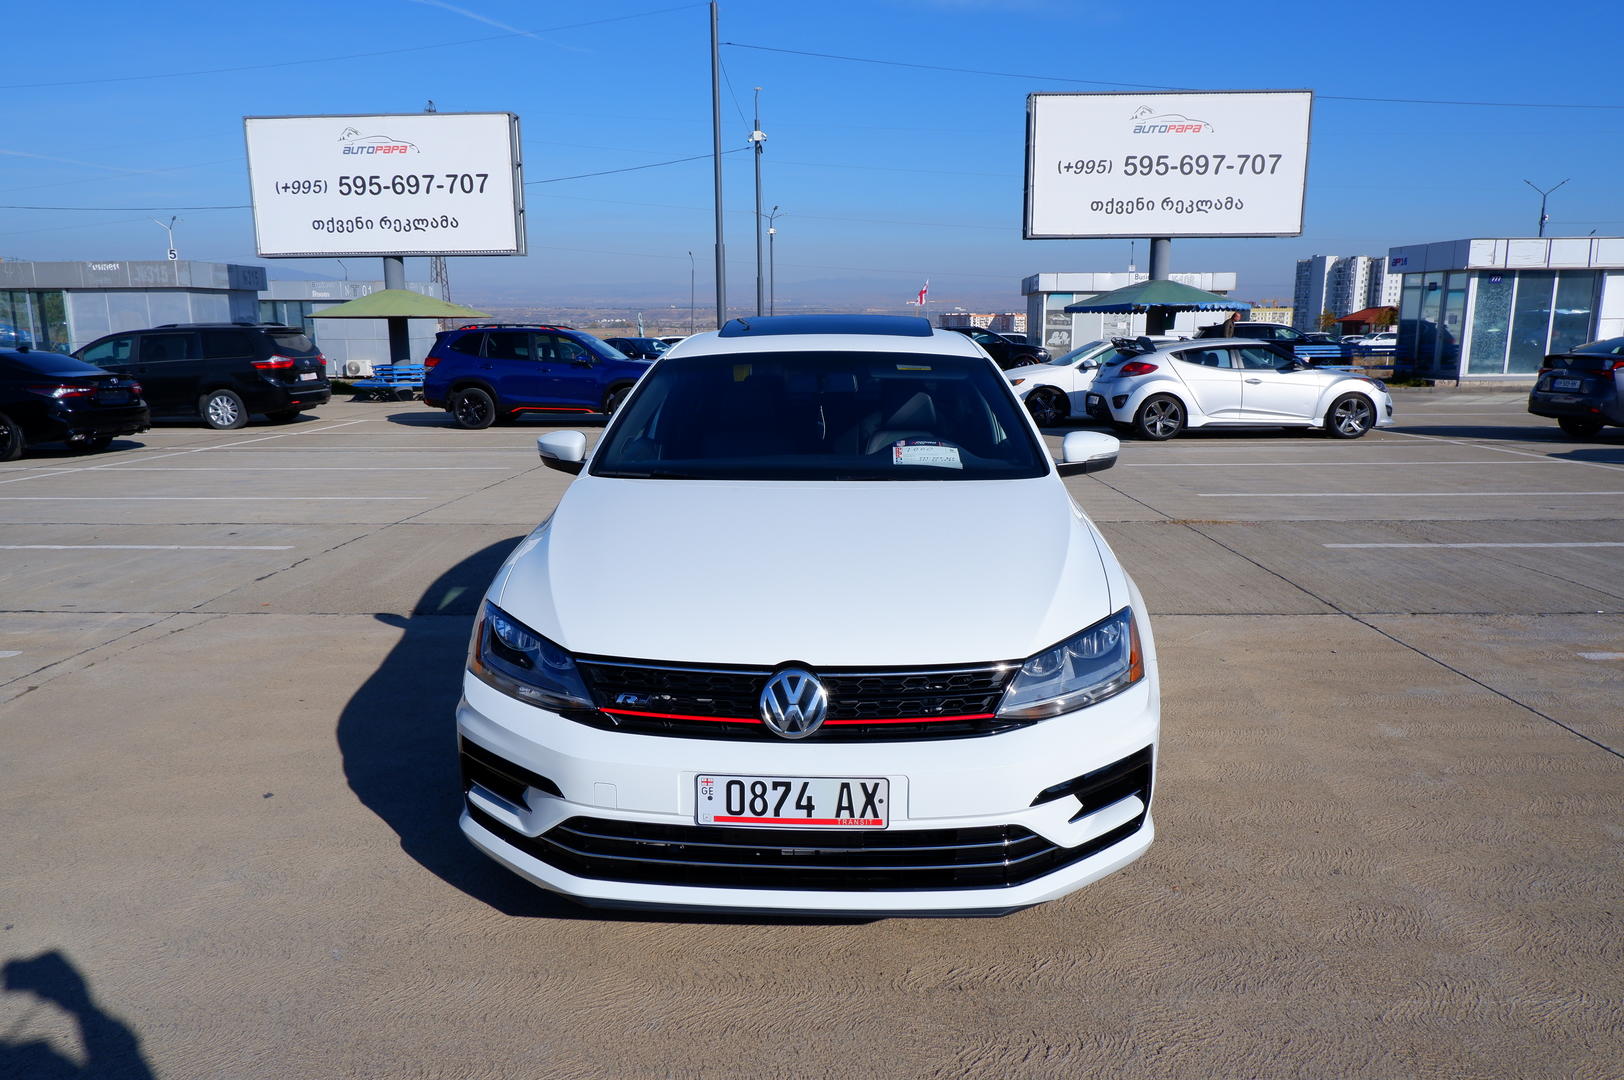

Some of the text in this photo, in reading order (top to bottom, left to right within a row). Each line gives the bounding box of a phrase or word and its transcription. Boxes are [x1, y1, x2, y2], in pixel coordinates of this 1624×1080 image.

[1057, 154, 1283, 177] (+995) 595-697-707
[275, 173, 489, 197] (+995) 595-697-707
[1090, 196, 1244, 215] თქვენი რეკლამა
[312, 215, 459, 233] თქვენი რეკლამა
[169, 249, 177, 260] 5
[701, 786, 714, 796] GE
[725, 779, 880, 819] 0874 AX
[837, 818, 874, 826] TRANSIT
